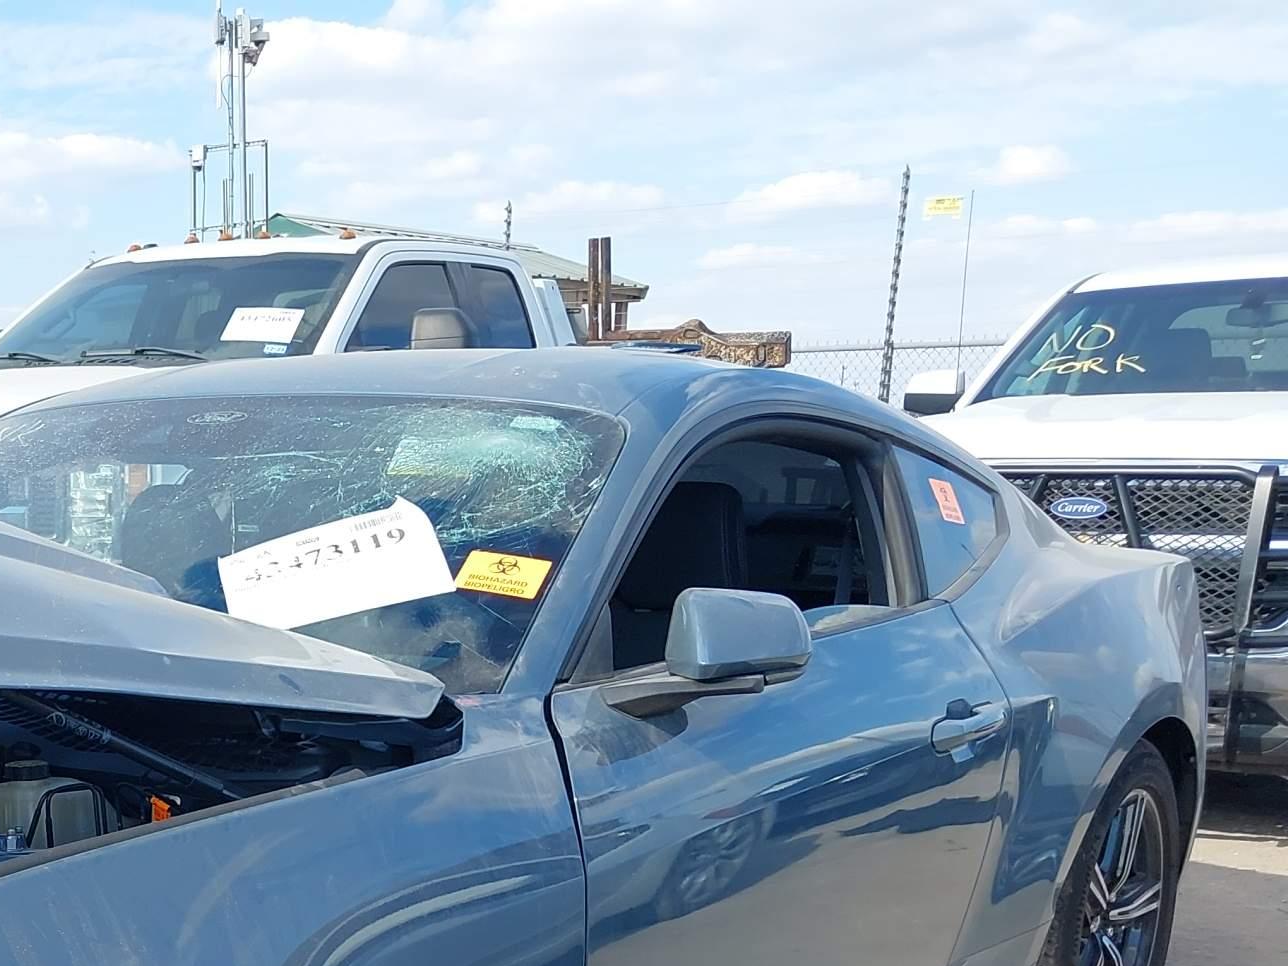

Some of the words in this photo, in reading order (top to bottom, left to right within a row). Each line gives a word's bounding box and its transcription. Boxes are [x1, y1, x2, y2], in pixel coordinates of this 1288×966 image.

[1037, 324, 1116, 354] NO
[1026, 353, 1146, 383] FORK
[1057, 502, 1101, 513] Carrier
[463, 580, 526, 595] BIOPELIGRO
[468, 573, 529, 588] BIOHAZARD
